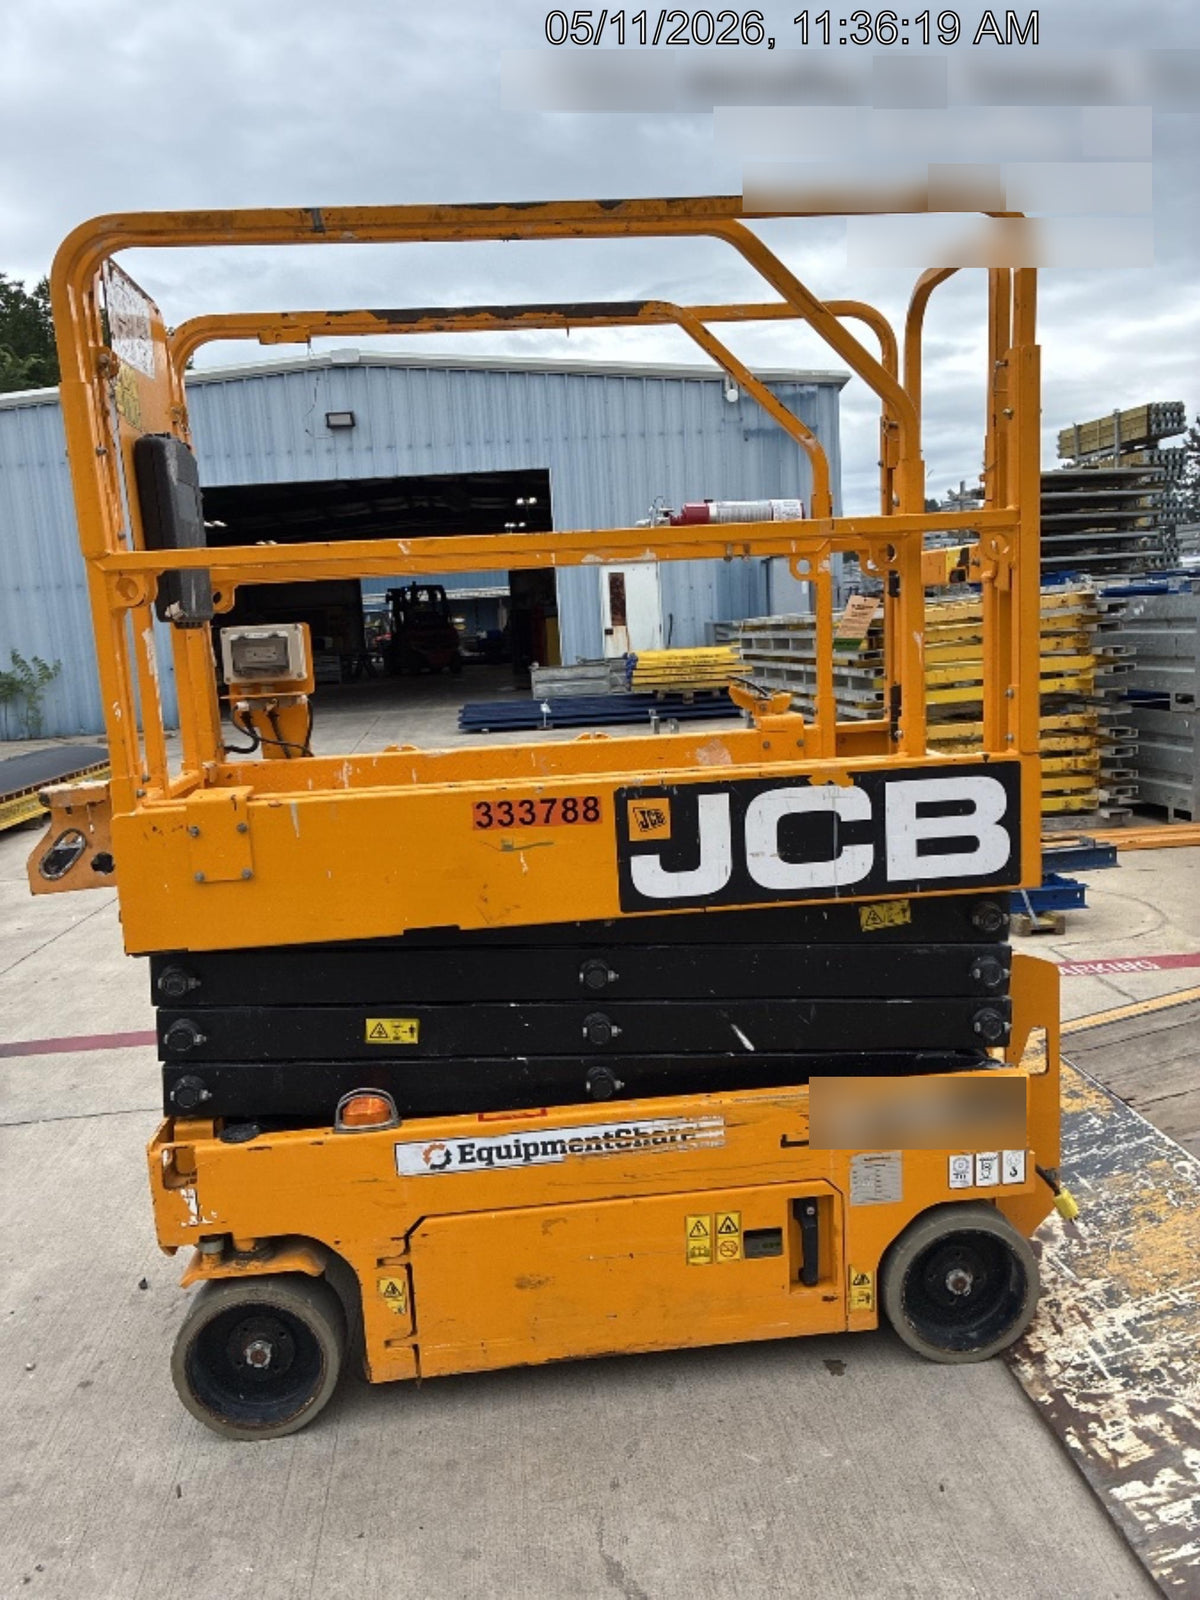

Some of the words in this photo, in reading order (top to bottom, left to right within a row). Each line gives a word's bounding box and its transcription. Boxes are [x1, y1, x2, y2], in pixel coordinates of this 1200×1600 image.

[475, 795, 600, 828] 333788
[636, 808, 666, 830] JCB
[630, 776, 1011, 899] JCB
[1060, 960, 1161, 975] ARKING
